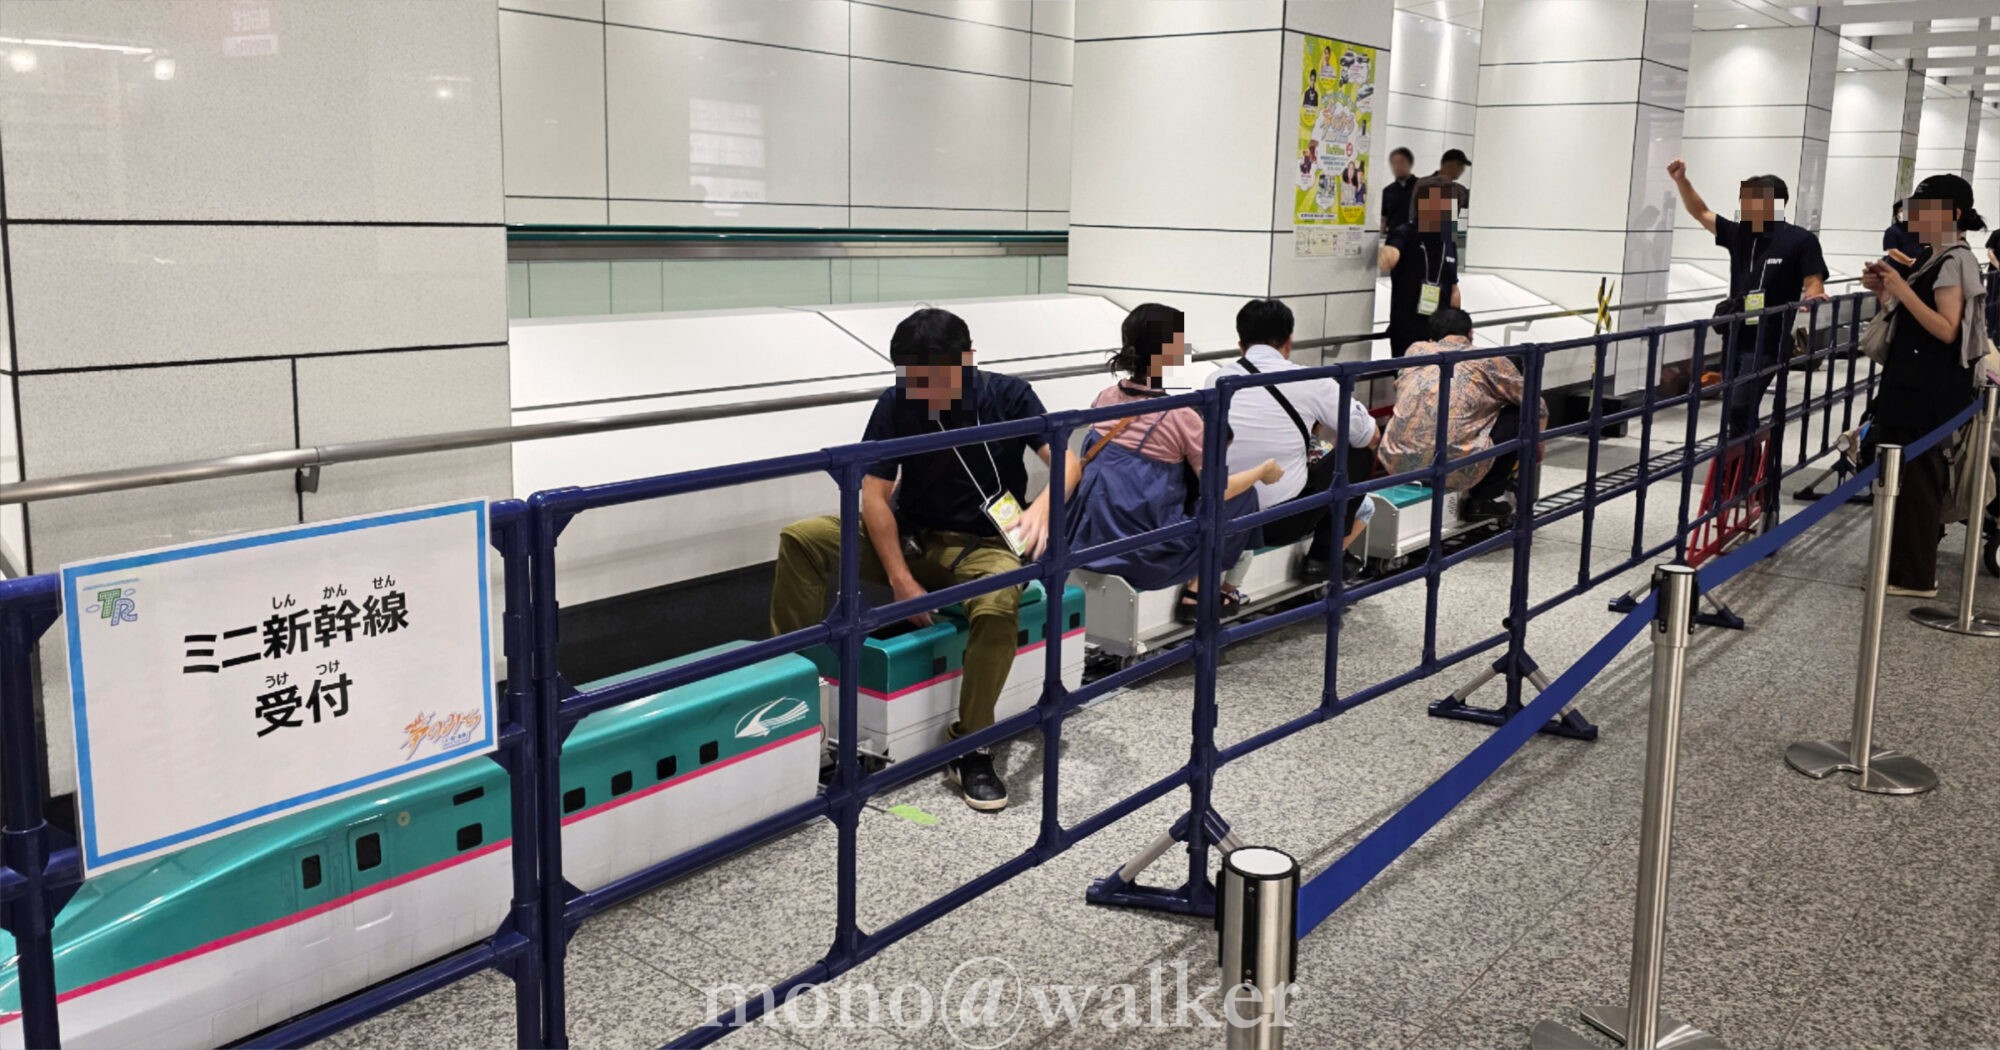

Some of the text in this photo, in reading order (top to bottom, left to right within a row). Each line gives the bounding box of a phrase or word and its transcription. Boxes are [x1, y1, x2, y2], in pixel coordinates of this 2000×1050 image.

[272, 574, 396, 610] しん かん せん
[183, 590, 409, 674] ミニ新幹線
[265, 660, 340, 688] うけ つけ
[255, 672, 353, 738] 受付
